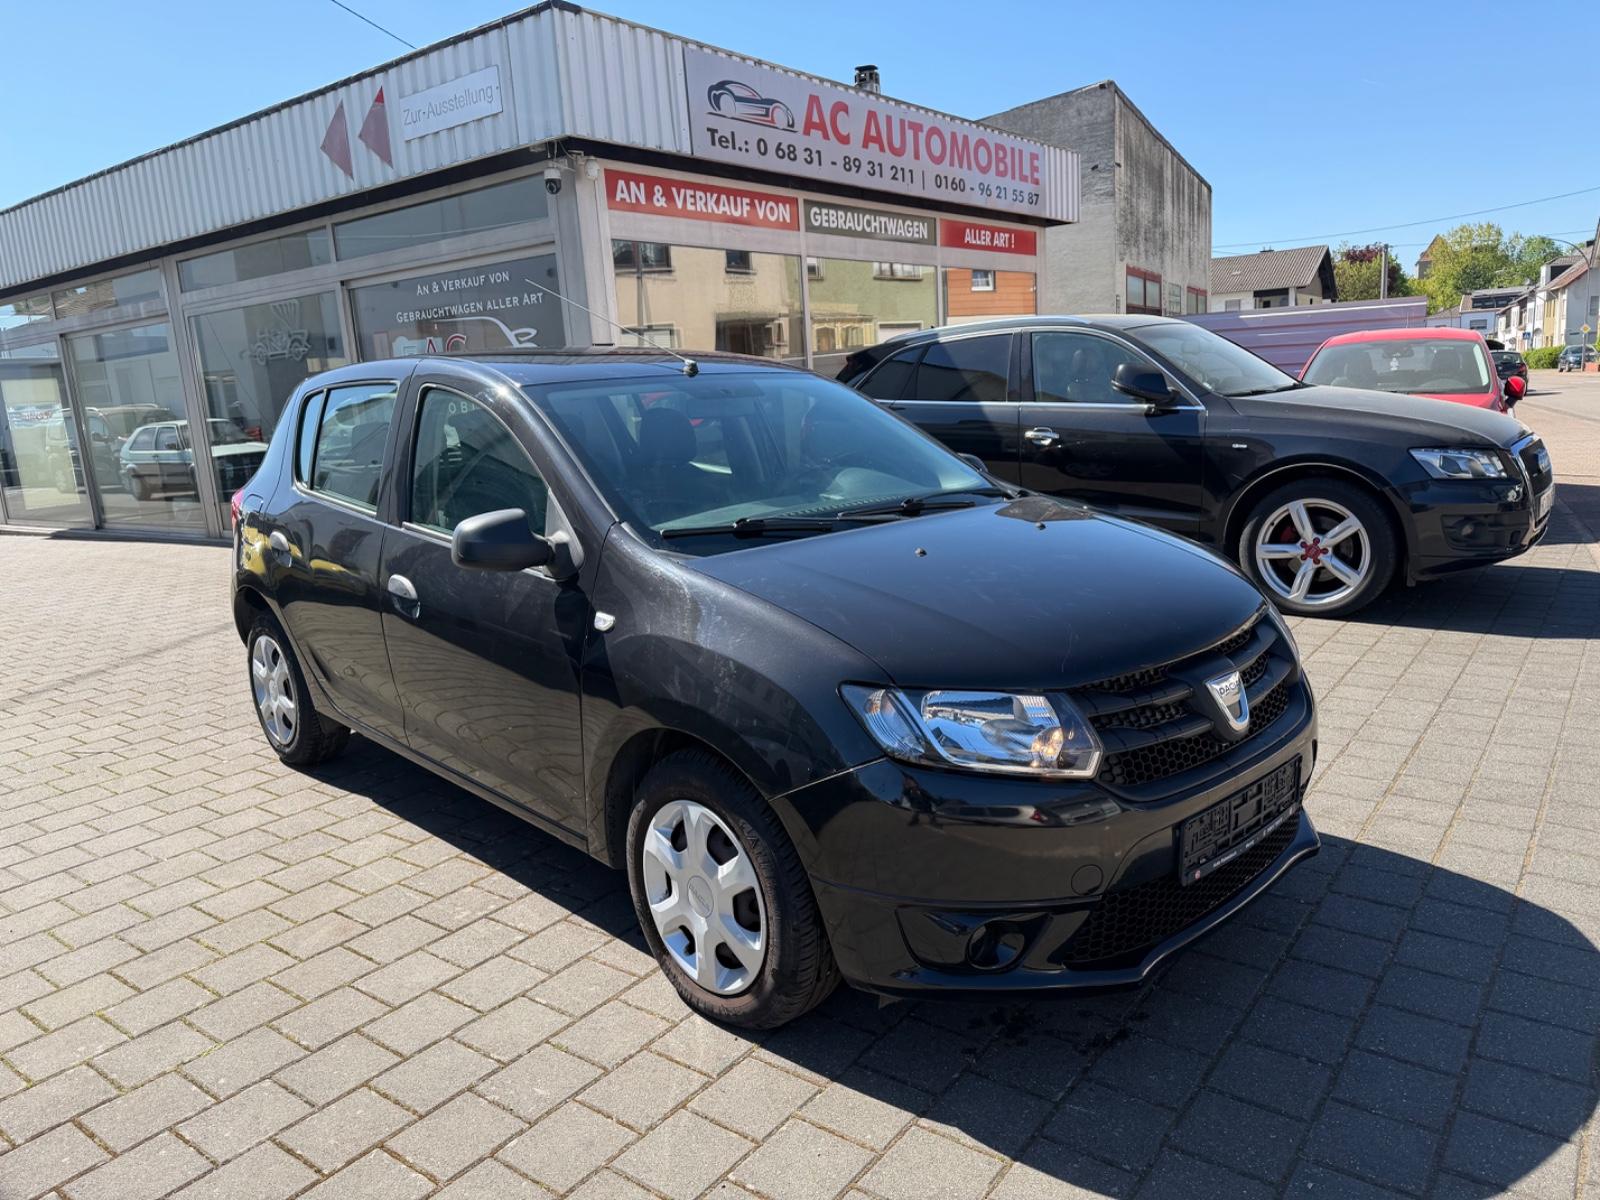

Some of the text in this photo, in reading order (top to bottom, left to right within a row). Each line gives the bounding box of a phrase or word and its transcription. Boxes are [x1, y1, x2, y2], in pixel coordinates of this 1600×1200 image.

[403, 84, 494, 126] Zur Ausstellung
[802, 93, 1041, 186] AC AUTOMOBILE
[706, 127, 750, 153] Tel.:
[756, 137, 769, 157] 0
[775, 141, 798, 162] 68
[803, 147, 823, 168] 31
[842, 155, 862, 174] 89
[867, 160, 883, 178] 31
[890, 165, 914, 184] 211
[934, 173, 966, 192] 0160
[978, 182, 992, 197] 96
[995, 185, 1008, 200] 21
[1011, 189, 1025, 203] 55
[1027, 192, 1040, 206] 87
[615, 179, 791, 223] AN & VERKAUF VON
[810, 206, 928, 239] GEBRAUCHTWAGEN
[964, 228, 992, 246] ALLER
[993, 231, 1010, 248] ART
[441, 275, 486, 292] VERKAUF
[396, 302, 484, 323] GEBRAUCHTWAGEN
[522, 292, 544, 306] ART
